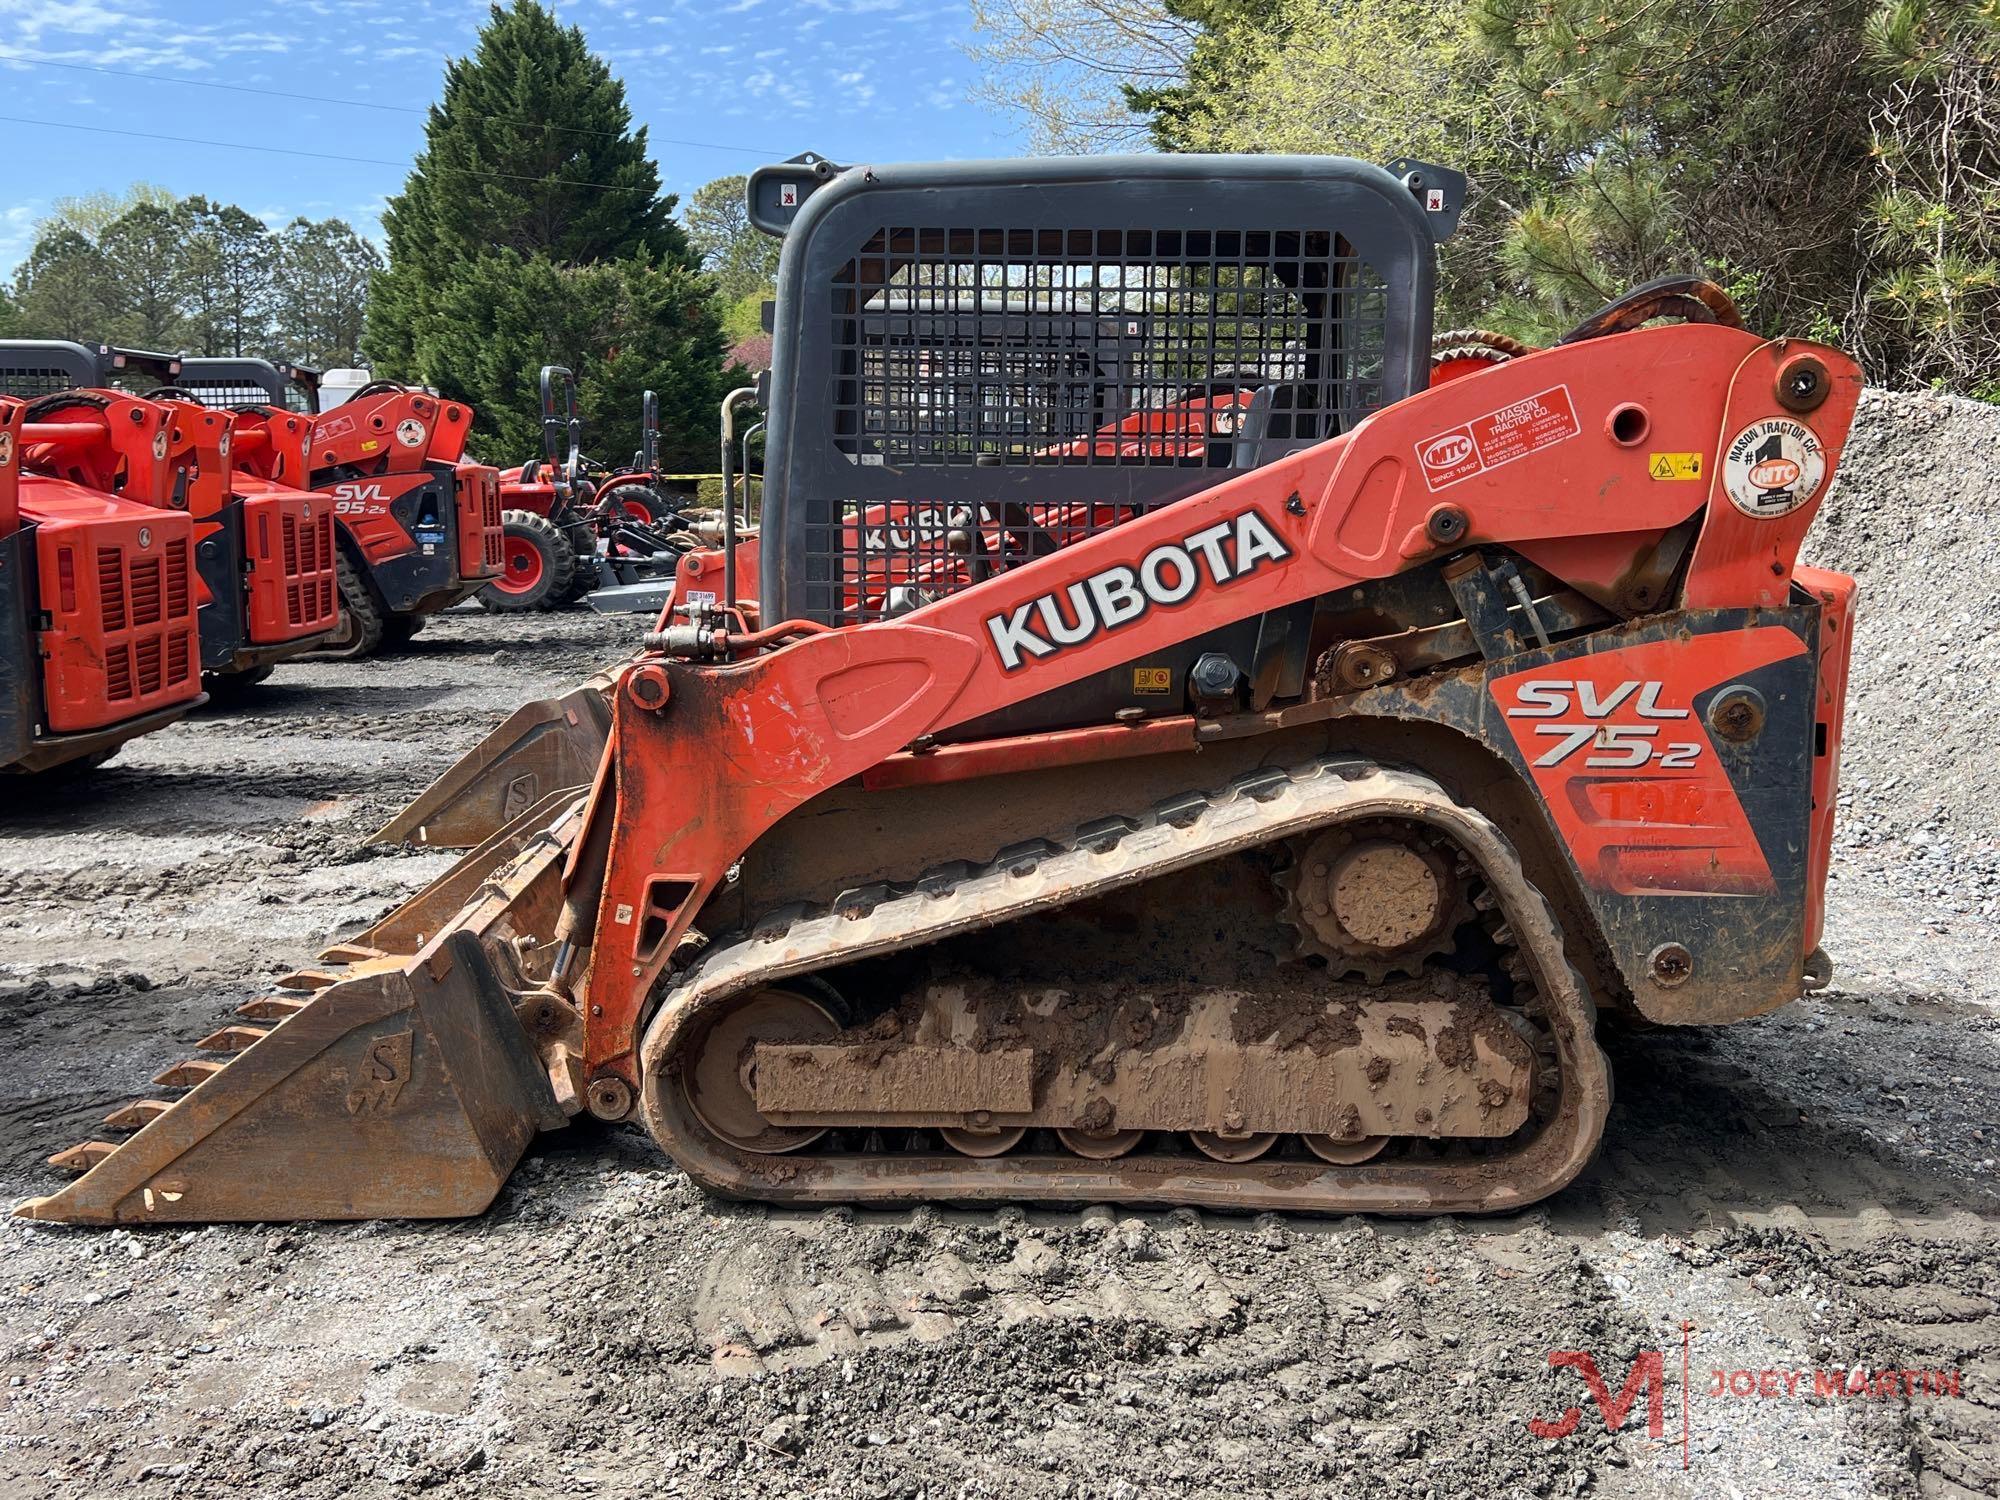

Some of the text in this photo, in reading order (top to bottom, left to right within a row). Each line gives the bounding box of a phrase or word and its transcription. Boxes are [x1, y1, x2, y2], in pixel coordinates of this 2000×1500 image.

[1489, 406, 1551, 436] TRACTOR CO.
[1494, 399, 1540, 424] MASON
[1429, 438, 1469, 464] MTC
[1729, 421, 1818, 462] MASON TRACTOR CO.
[1456, 460, 1478, 475] 1940"
[1756, 464, 1796, 484] MTC
[332, 485, 391, 500] SVL
[333, 501, 387, 514] 95-2s
[987, 511, 1288, 670] KUBOTA
[1506, 681, 1690, 718] SVL
[1532, 724, 1702, 768] 75-2
